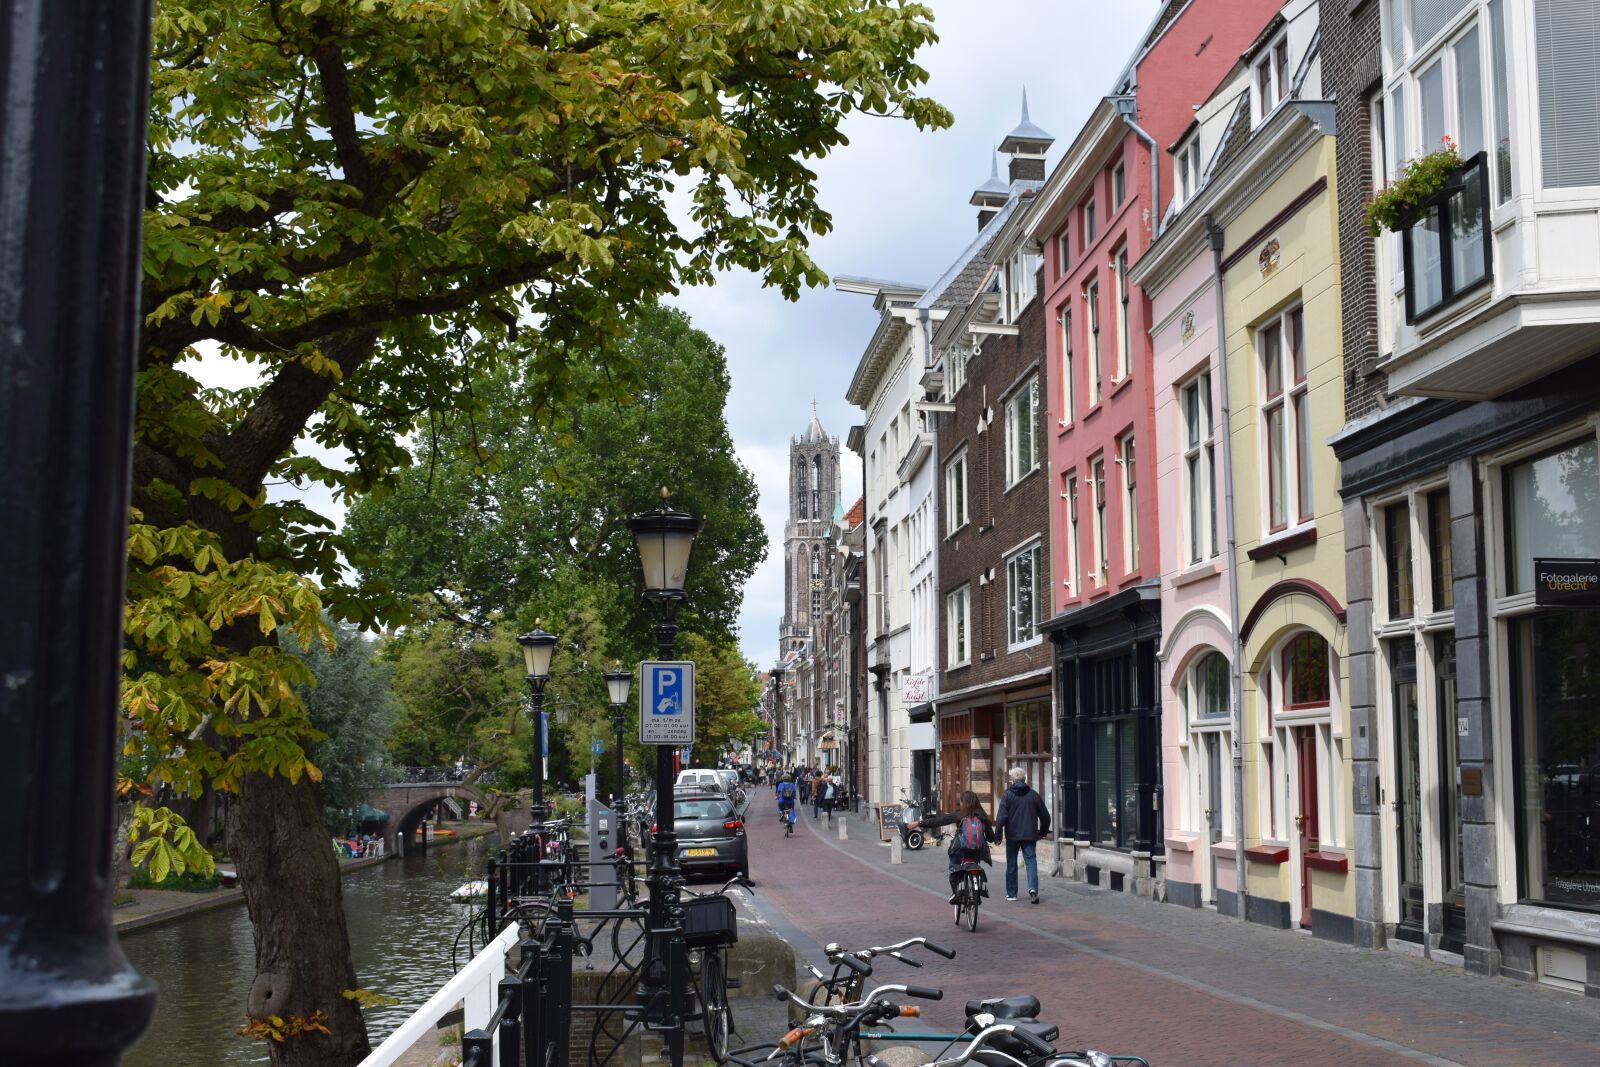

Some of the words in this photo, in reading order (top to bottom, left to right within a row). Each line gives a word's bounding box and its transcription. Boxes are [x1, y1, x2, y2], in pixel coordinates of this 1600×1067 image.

[1540, 572, 1598, 584] Fotogalerie
[1548, 581, 1588, 591] Utrecht
[658, 670, 677, 696] P
